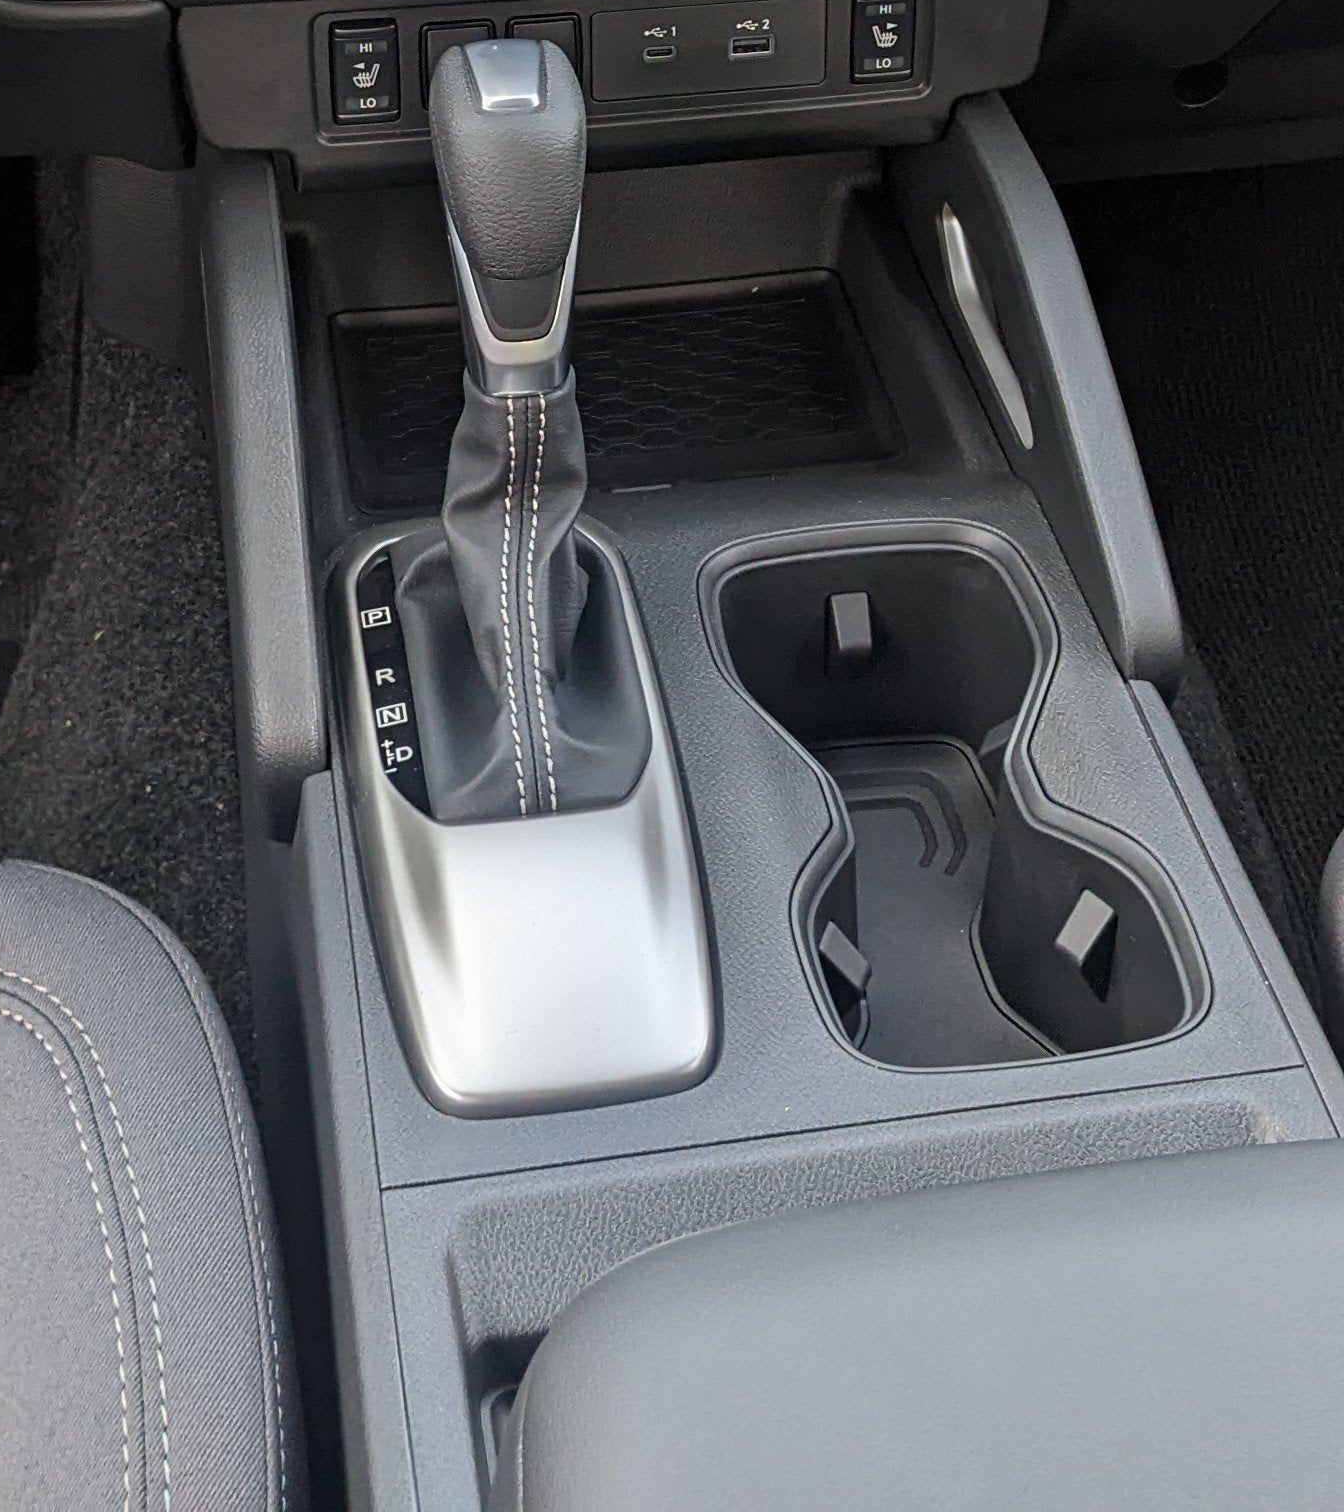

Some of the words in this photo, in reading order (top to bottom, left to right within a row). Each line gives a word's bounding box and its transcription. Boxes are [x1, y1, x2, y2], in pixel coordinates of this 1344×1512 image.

[878, 3, 893, 15] HI
[761, 19, 770, 30] 2
[670, 26, 677, 37] 1
[359, 42, 373, 53] HI
[875, 57, 892, 69] LO
[359, 97, 377, 109] LO
[374, 667, 396, 686] R
[395, 745, 414, 763] D
